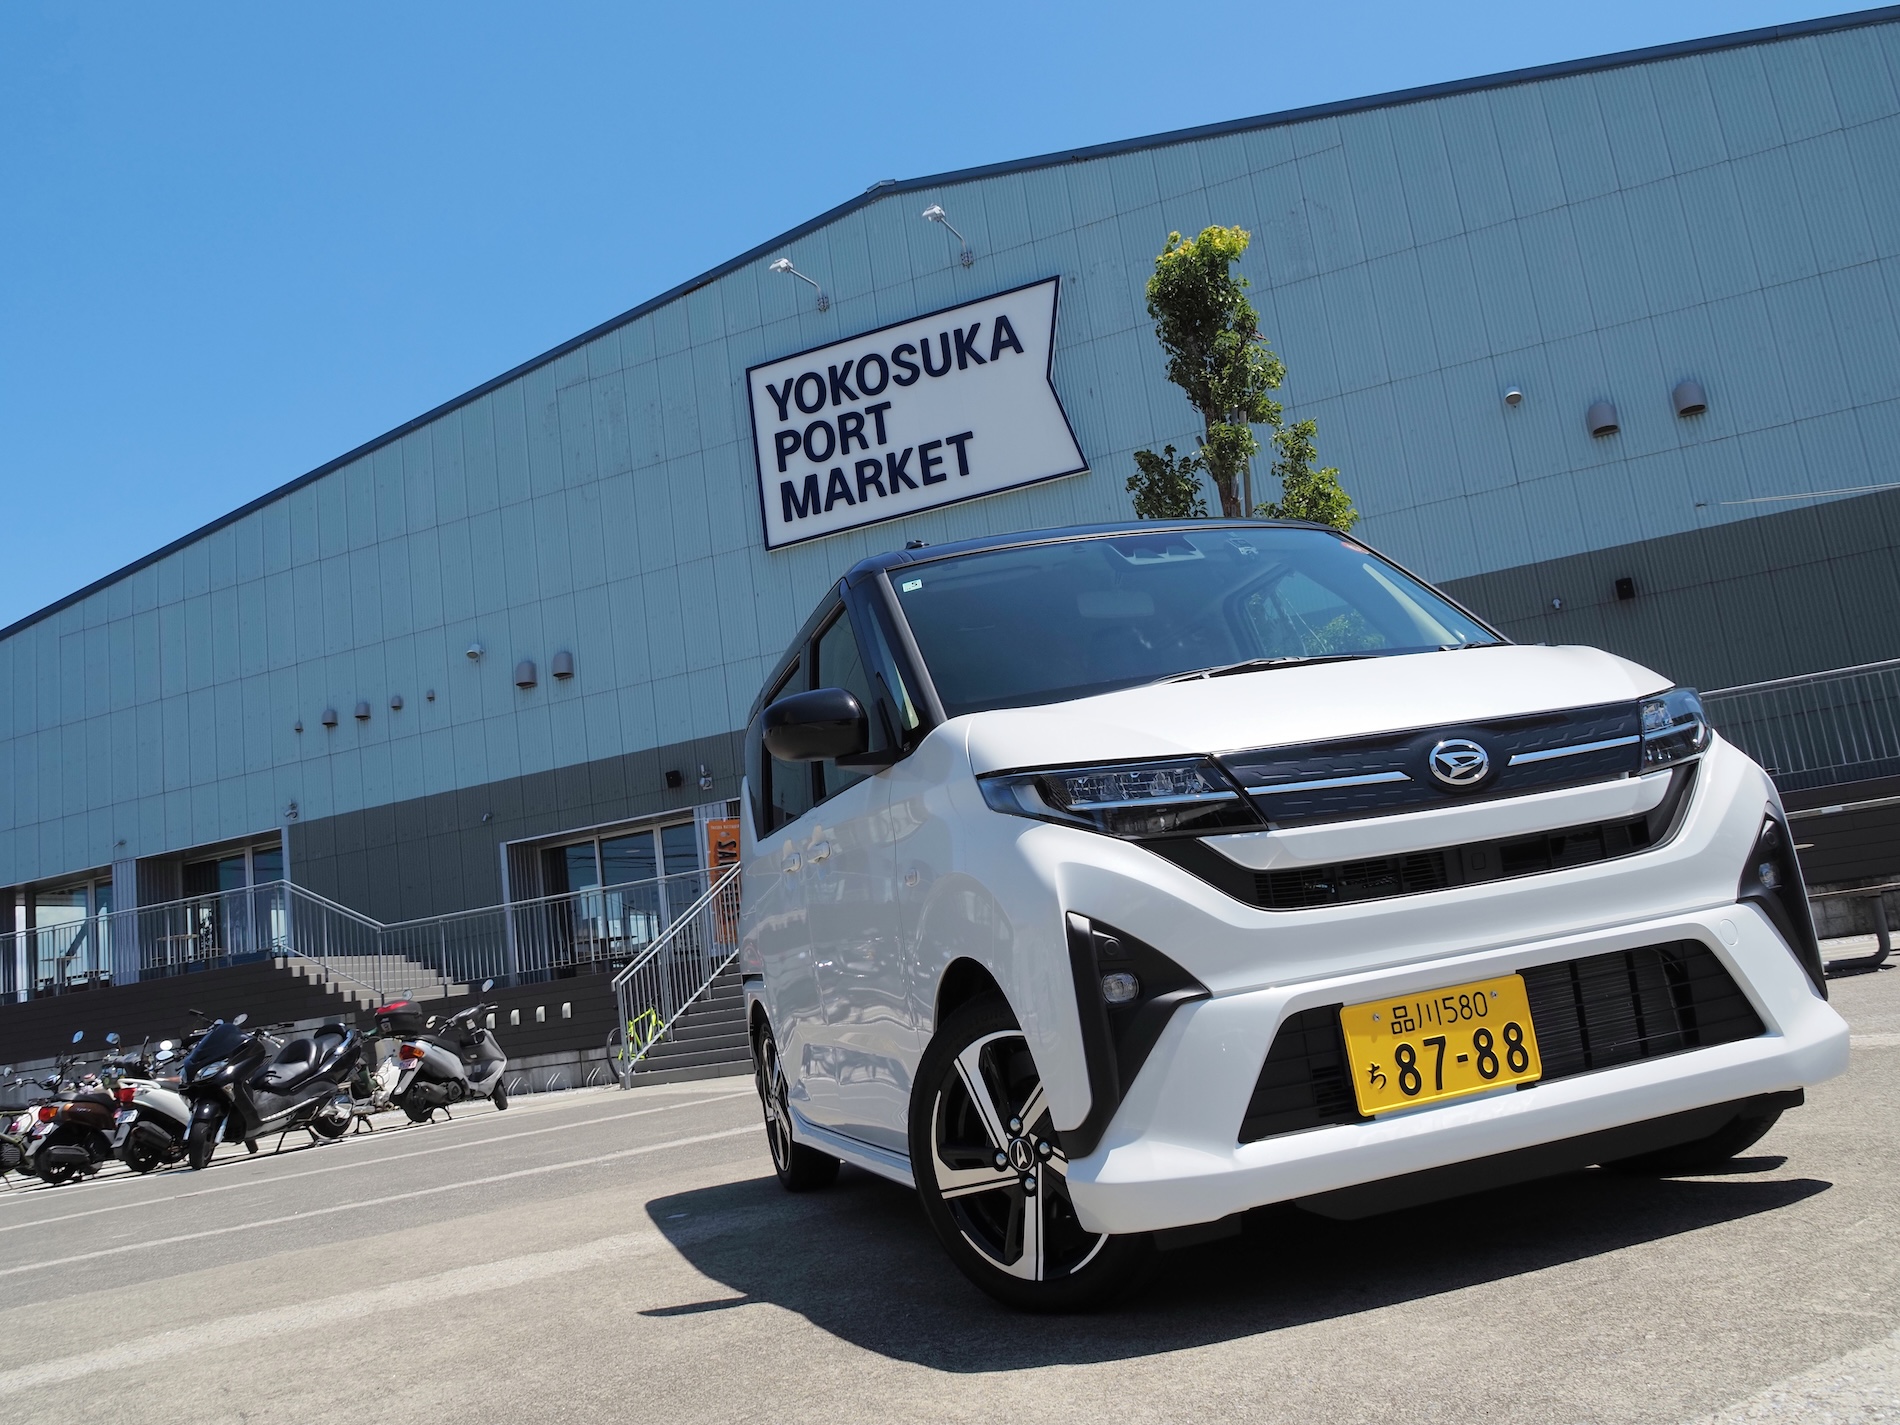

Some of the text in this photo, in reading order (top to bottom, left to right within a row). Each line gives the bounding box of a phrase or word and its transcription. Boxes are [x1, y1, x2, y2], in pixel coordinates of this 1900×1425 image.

[766, 315, 1024, 421] YOKOSUKA
[775, 401, 891, 472] PORT
[780, 431, 974, 522] MARKET
[1367, 1021, 1529, 1096] ち 87-88
